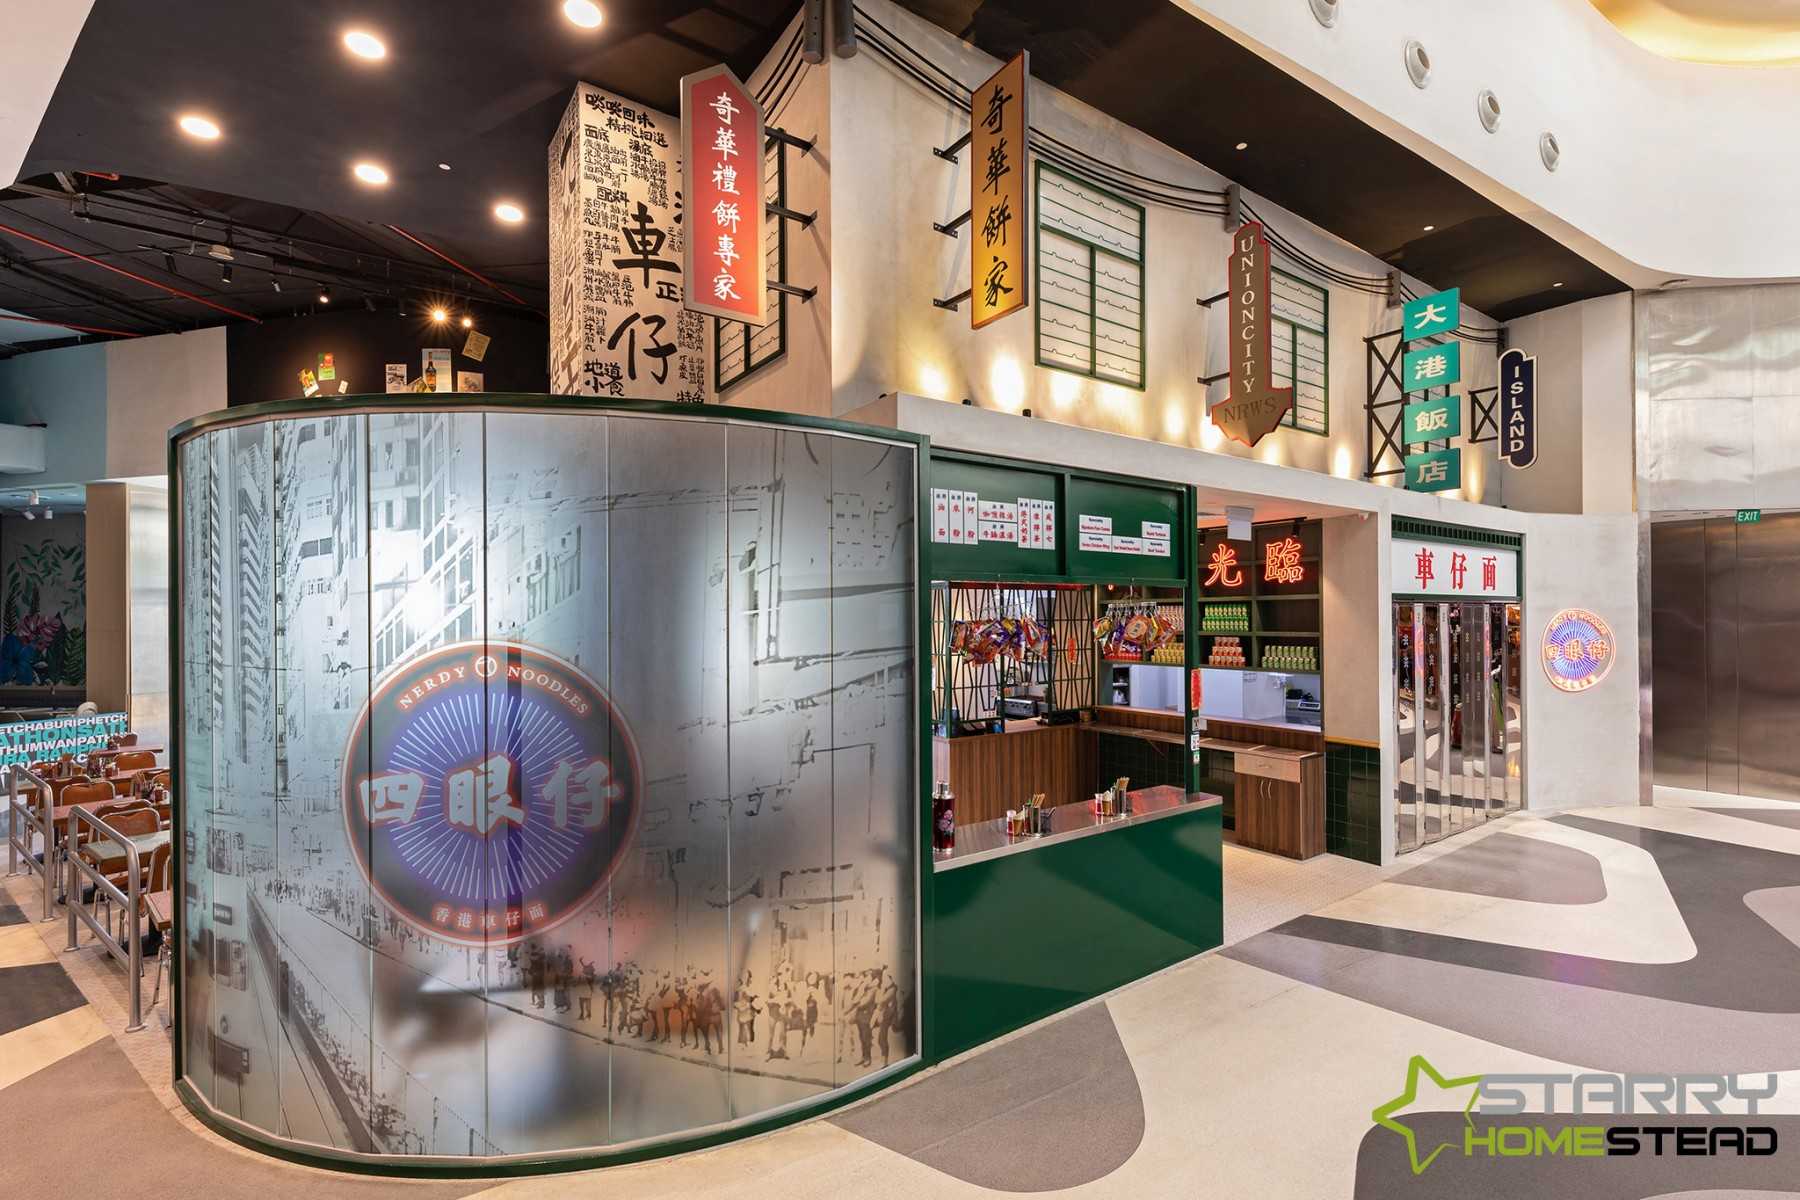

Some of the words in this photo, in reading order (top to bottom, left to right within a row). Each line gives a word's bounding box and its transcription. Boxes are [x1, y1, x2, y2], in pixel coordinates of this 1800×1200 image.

[709, 92, 742, 301] 奇華禮餅專家
[981, 85, 1014, 307] 奇華餅家
[656, 280, 683, 302] 正
[1414, 303, 1448, 484] 大港飯店
[1509, 366, 1525, 452] ISLAND
[1738, 511, 1758, 521] EXIT
[1204, 538, 1304, 587] 光臨
[399, 666, 466, 709] NERDY
[508, 665, 589, 715] NOODLES
[359, 755, 624, 834] 四眼仔
